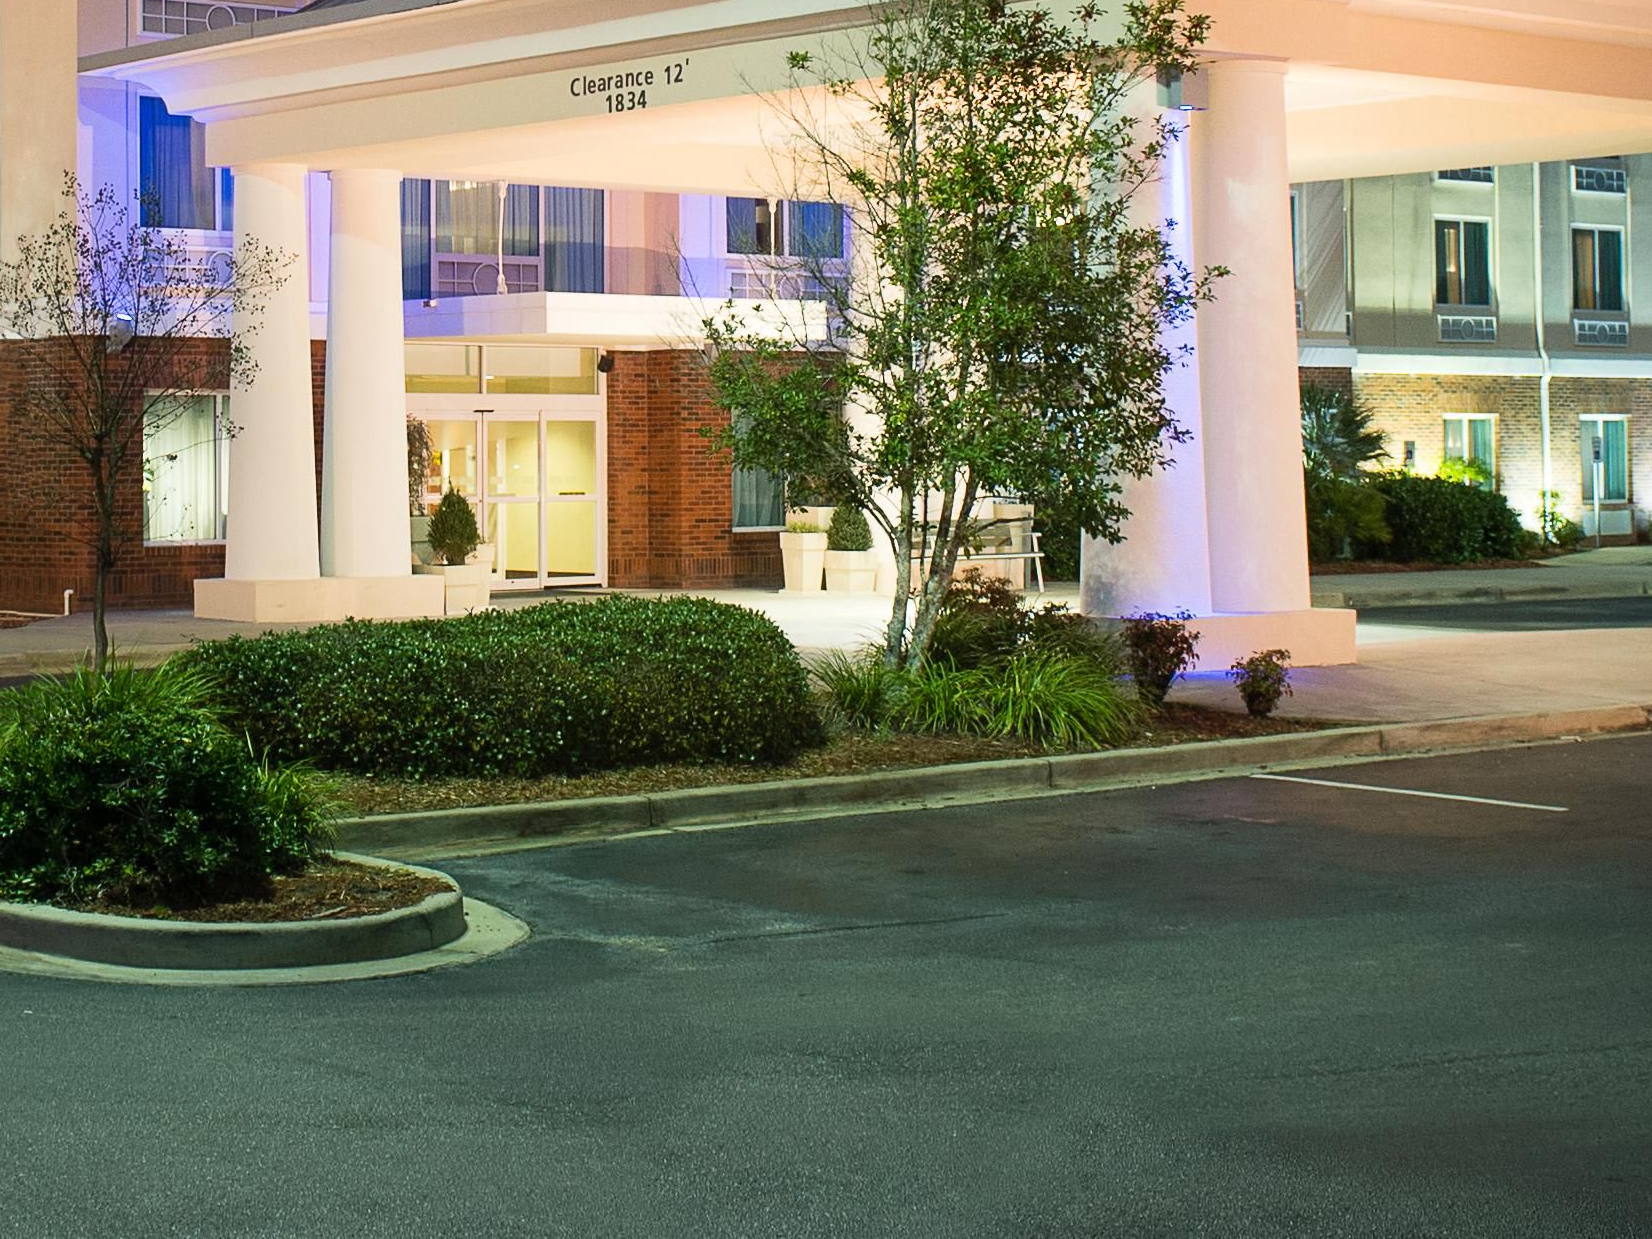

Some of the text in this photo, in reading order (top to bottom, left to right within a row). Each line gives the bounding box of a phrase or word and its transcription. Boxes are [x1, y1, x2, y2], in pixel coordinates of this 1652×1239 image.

[570, 58, 690, 97] Clearance 12'
[605, 90, 647, 113] 1834
